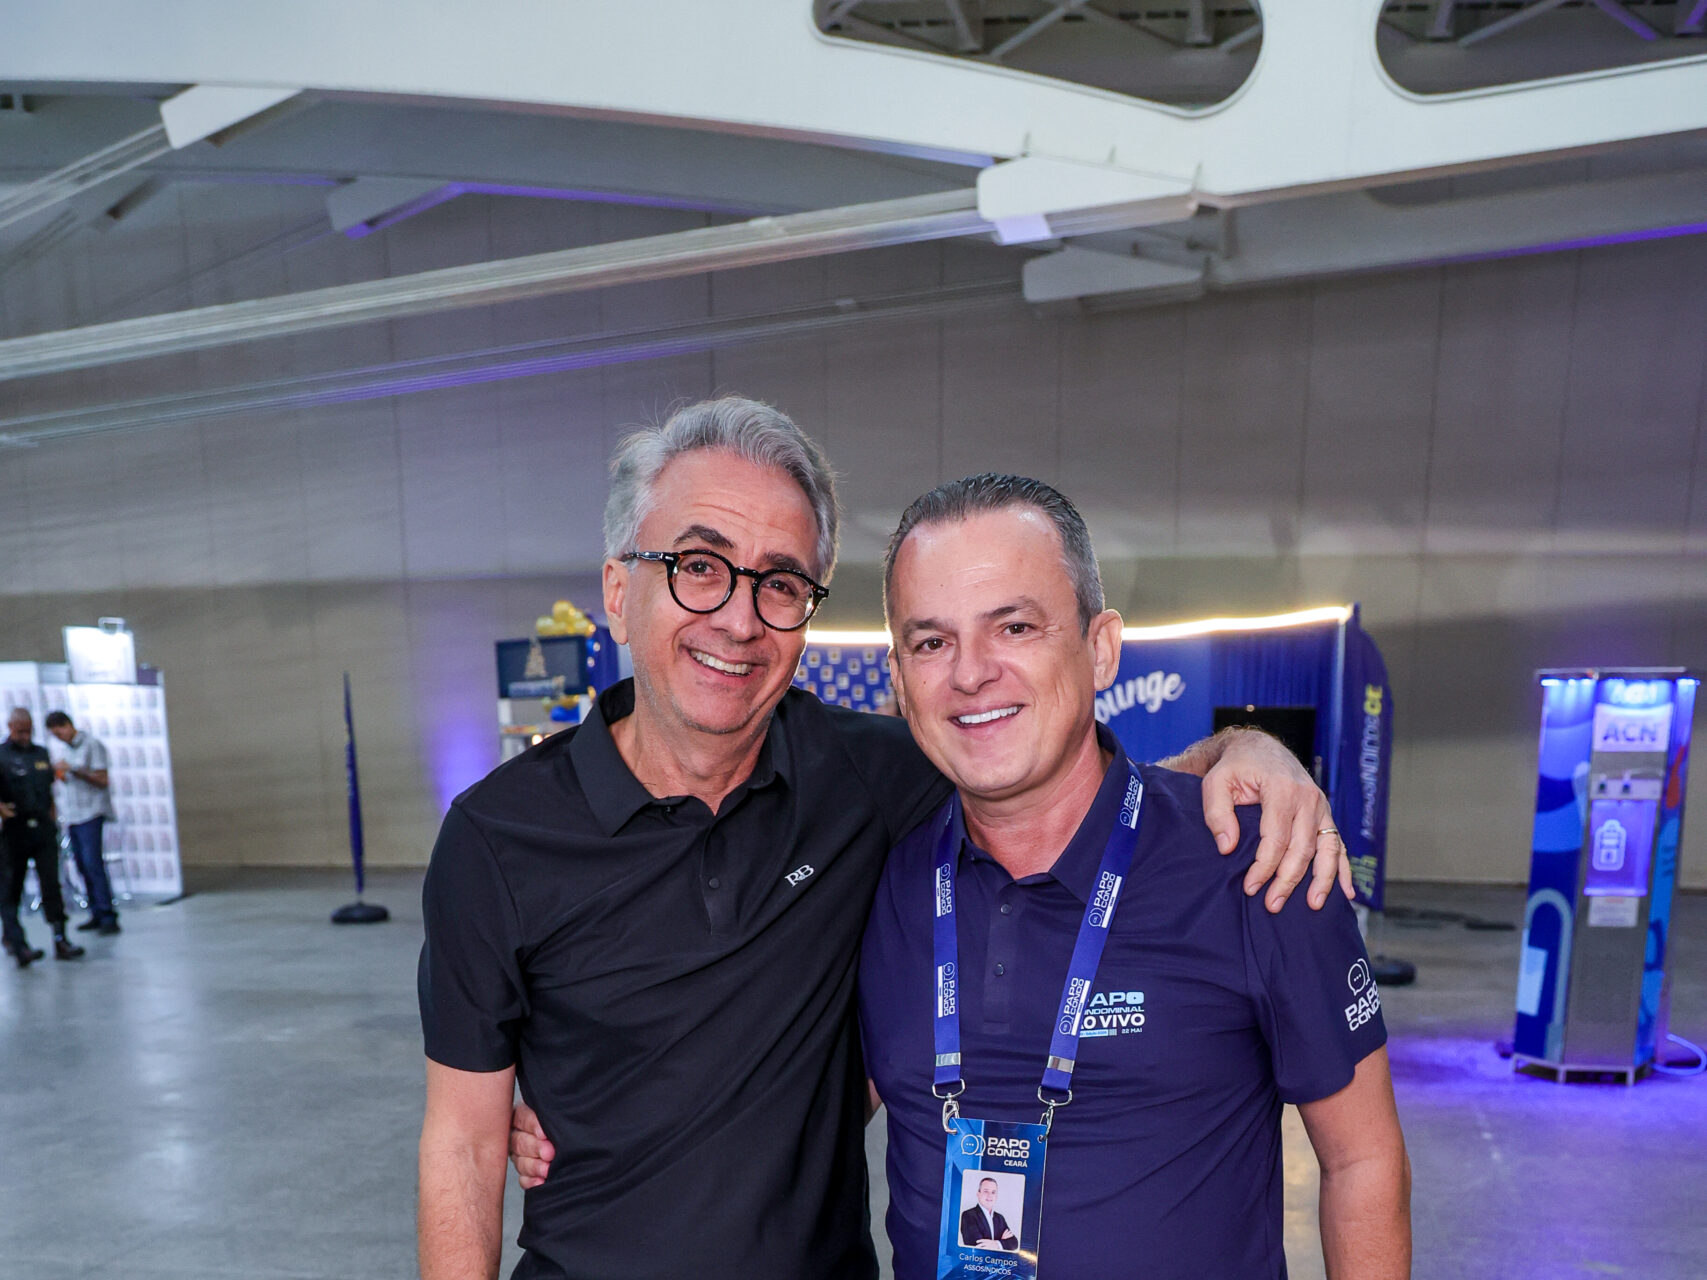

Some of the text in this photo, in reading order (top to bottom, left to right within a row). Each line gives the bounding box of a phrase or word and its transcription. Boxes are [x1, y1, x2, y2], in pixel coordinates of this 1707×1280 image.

[1094, 670, 1186, 725] ounge
[1602, 723, 1657, 742] ACN
[1124, 775, 1136, 807] PAPO
[1129, 779, 1139, 810] CONDO
[945, 880, 953, 914] PAPO
[1093, 871, 1110, 907] PAPO
[1101, 873, 1116, 908] CONDO
[1063, 977, 1079, 1014] PAPO
[1070, 978, 1085, 1015] CONDO
[1088, 991, 1145, 1007] APO
[1084, 1006, 1145, 1015] NDOMINIAL
[1099, 1013, 1145, 1028] VIVO
[987, 1147, 1030, 1159] CONDO
[988, 1137, 1030, 1150] PAPO
[1003, 1160, 1028, 1168] CEARÁ
[959, 1252, 1018, 1267] Carlos Campos
